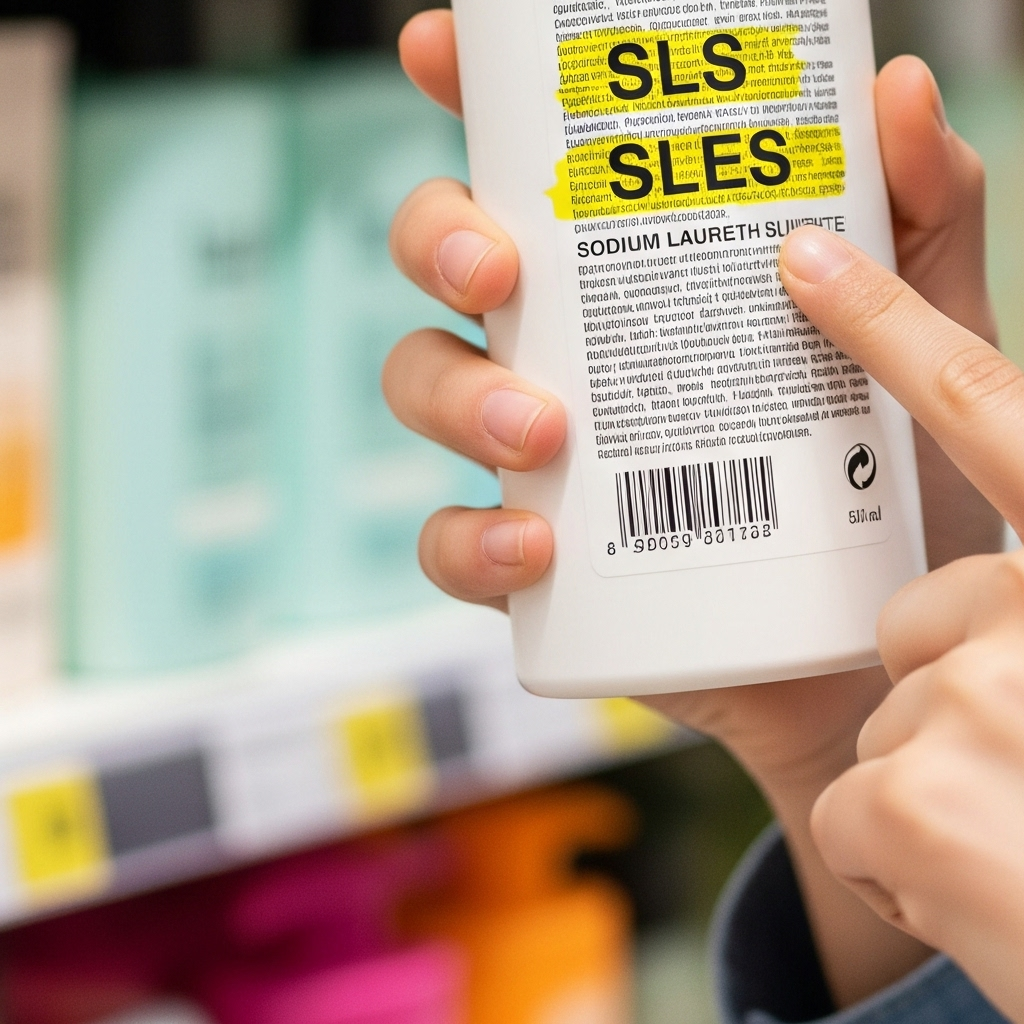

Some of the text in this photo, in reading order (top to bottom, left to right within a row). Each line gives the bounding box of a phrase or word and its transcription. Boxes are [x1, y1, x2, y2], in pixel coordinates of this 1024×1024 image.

[607, 33, 747, 101] SLS
[608, 129, 791, 200] SLES
[577, 233, 661, 258] SODIUM
[667, 222, 760, 247] LAURETH
[607, 542, 616, 555] 8
